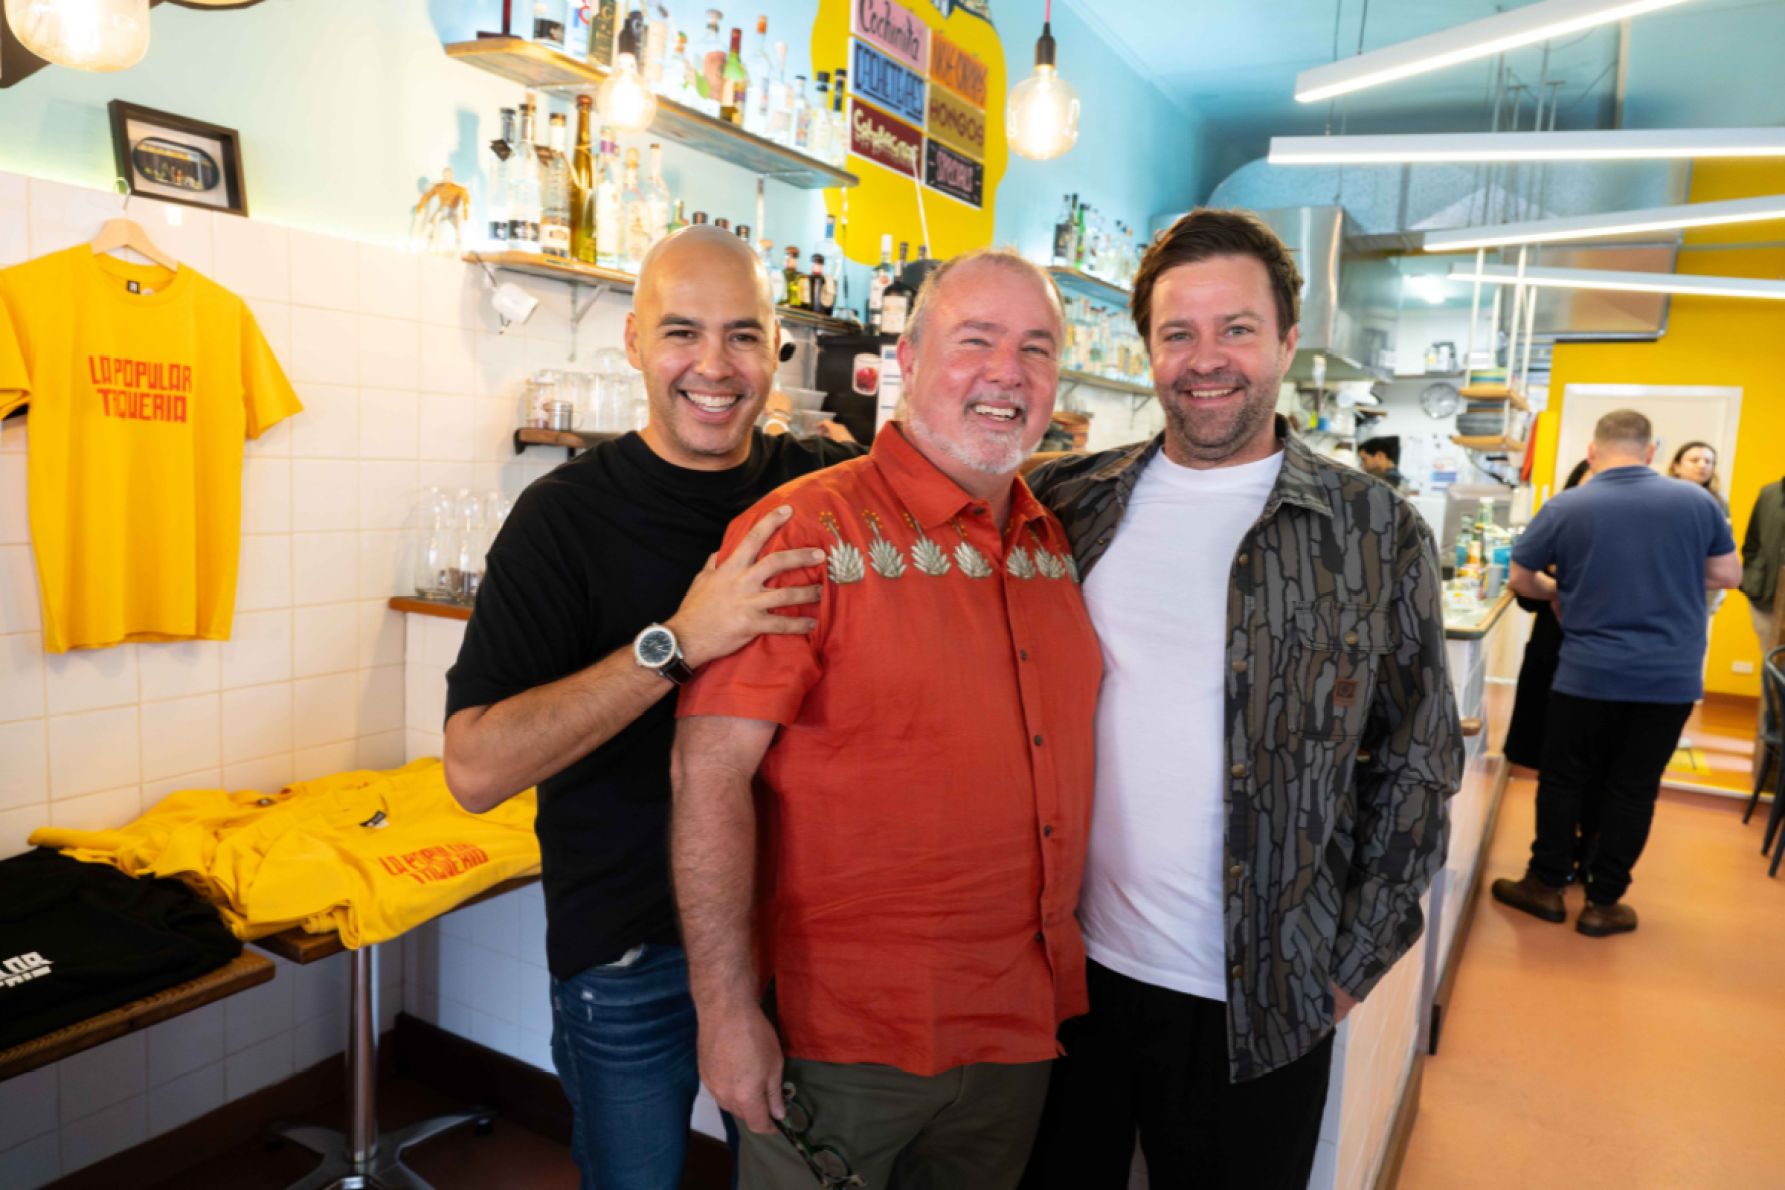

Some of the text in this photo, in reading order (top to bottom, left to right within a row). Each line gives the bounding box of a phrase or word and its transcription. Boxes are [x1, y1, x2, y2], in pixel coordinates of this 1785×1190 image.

[930, 96, 983, 146] HONGOS
[88, 355, 192, 391] LA POPULAR
[378, 855, 409, 876] LA
